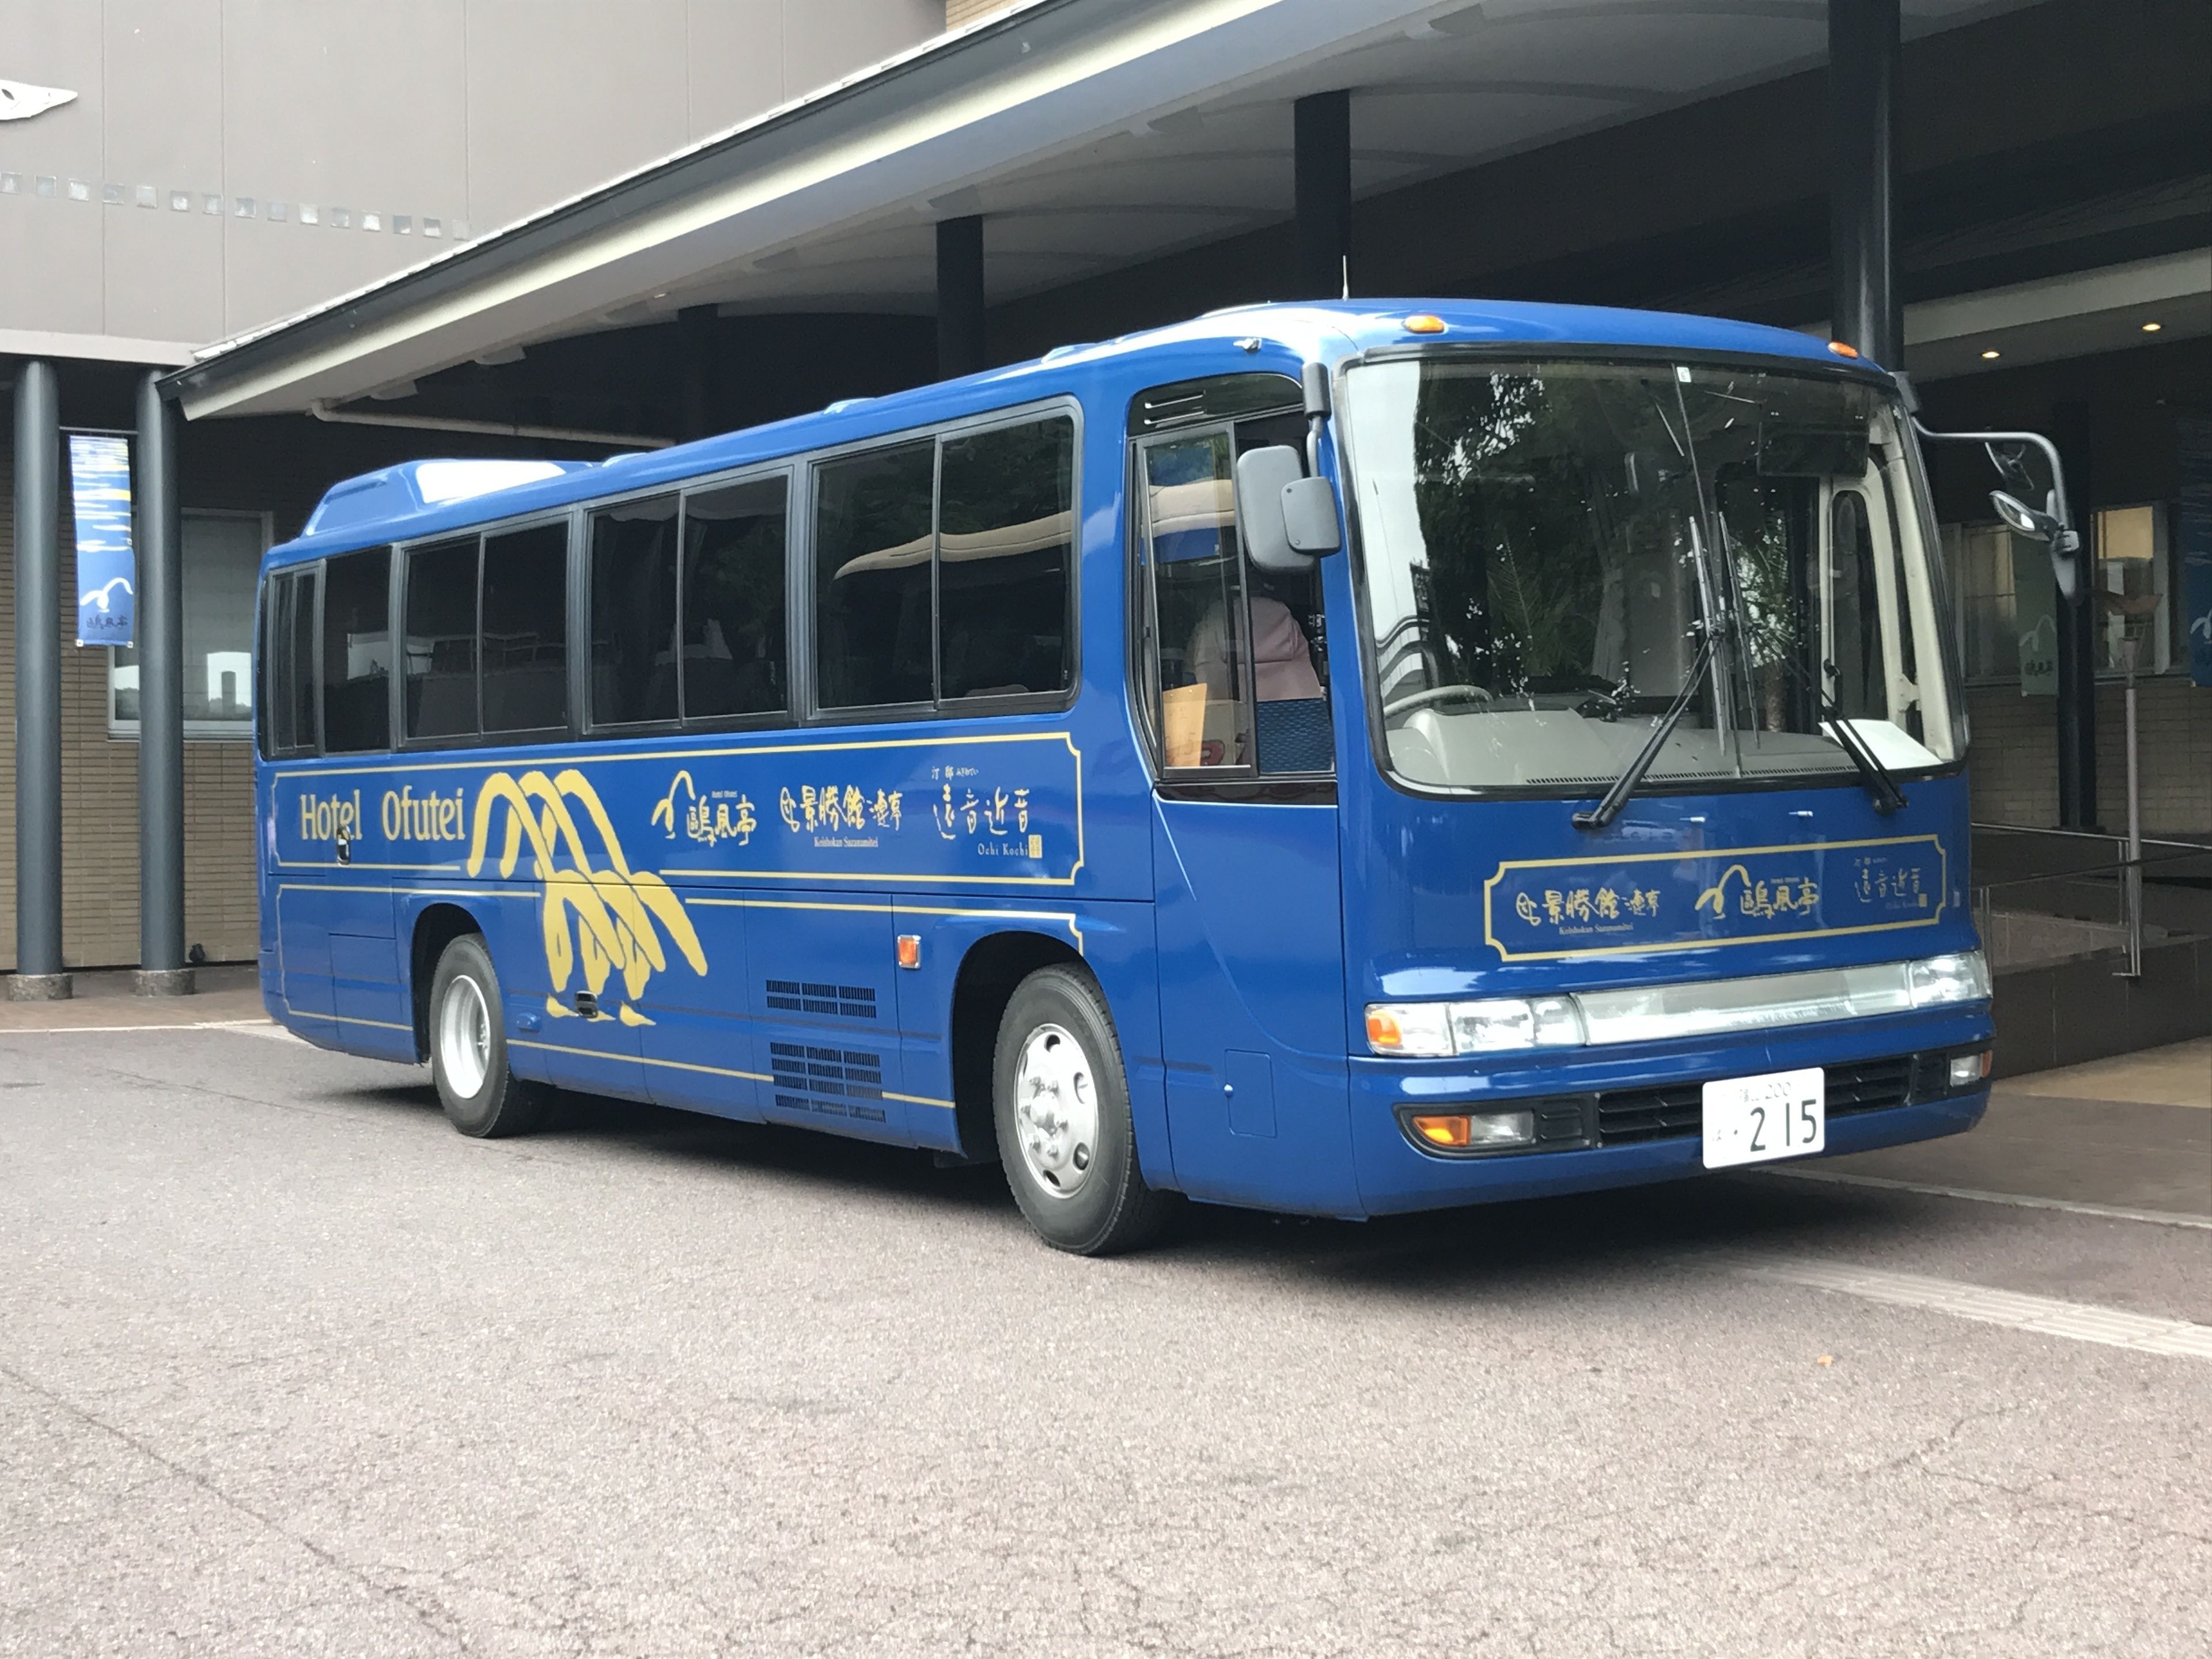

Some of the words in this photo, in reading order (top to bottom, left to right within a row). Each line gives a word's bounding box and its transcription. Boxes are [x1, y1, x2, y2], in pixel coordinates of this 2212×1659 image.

[300, 789, 362, 840] Hotel
[382, 785, 465, 841] Ofutei
[1002, 841, 1028, 856] Kochi
